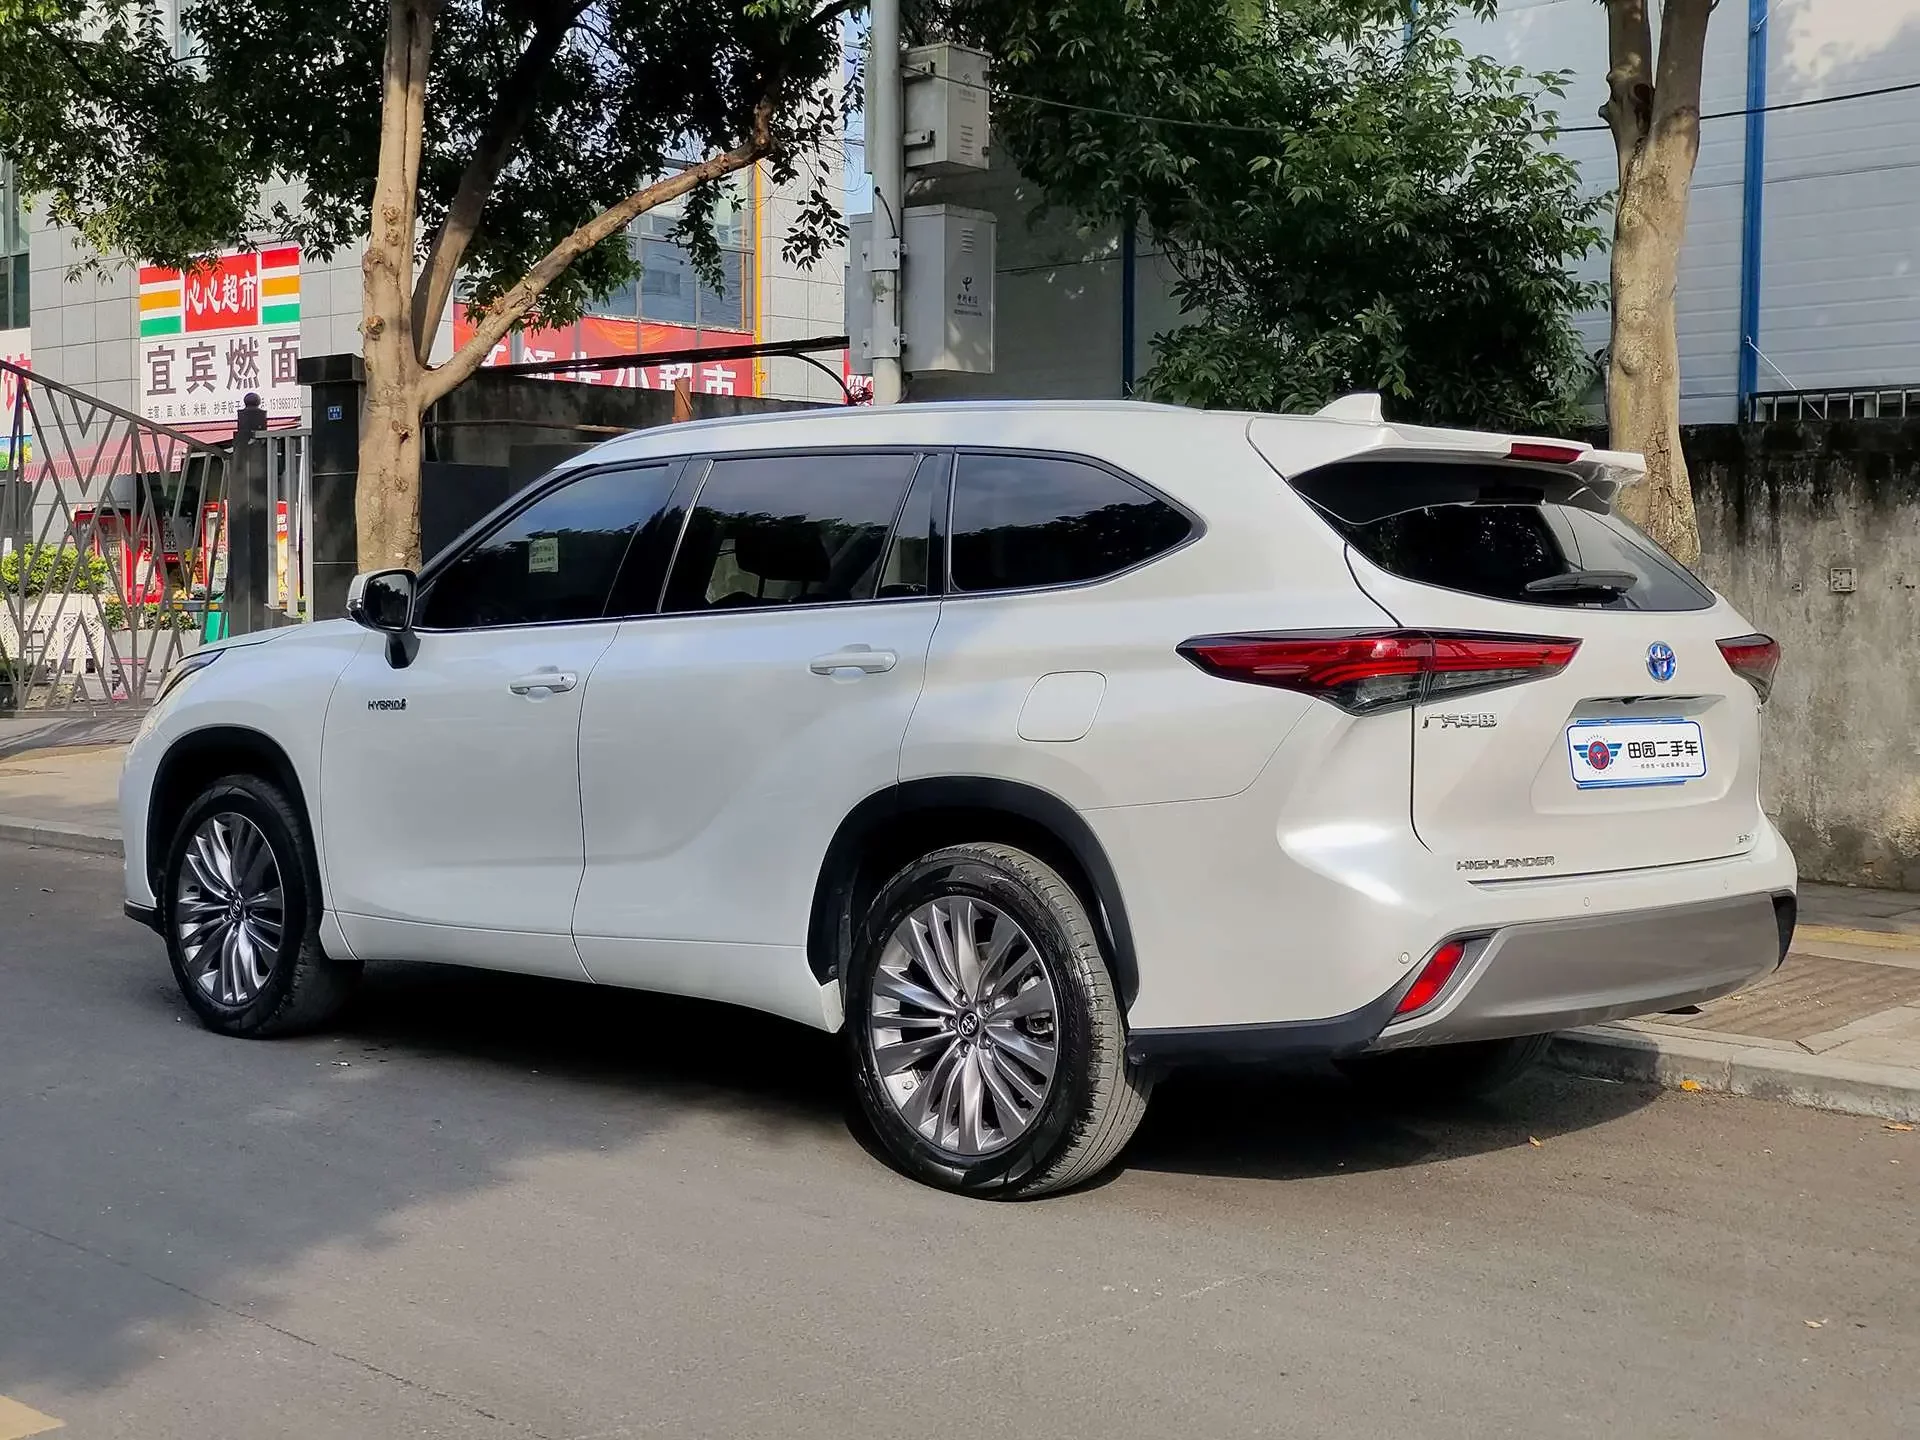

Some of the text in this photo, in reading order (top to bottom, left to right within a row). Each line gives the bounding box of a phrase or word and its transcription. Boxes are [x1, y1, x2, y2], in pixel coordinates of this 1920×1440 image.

[186, 270, 257, 315] 心心超市
[147, 335, 300, 396] 宜宾燃面
[367, 699, 402, 711] HYBRID
[1627, 740, 1699, 759] 田园二手车
[1456, 855, 1555, 871] HIGHLANDER
